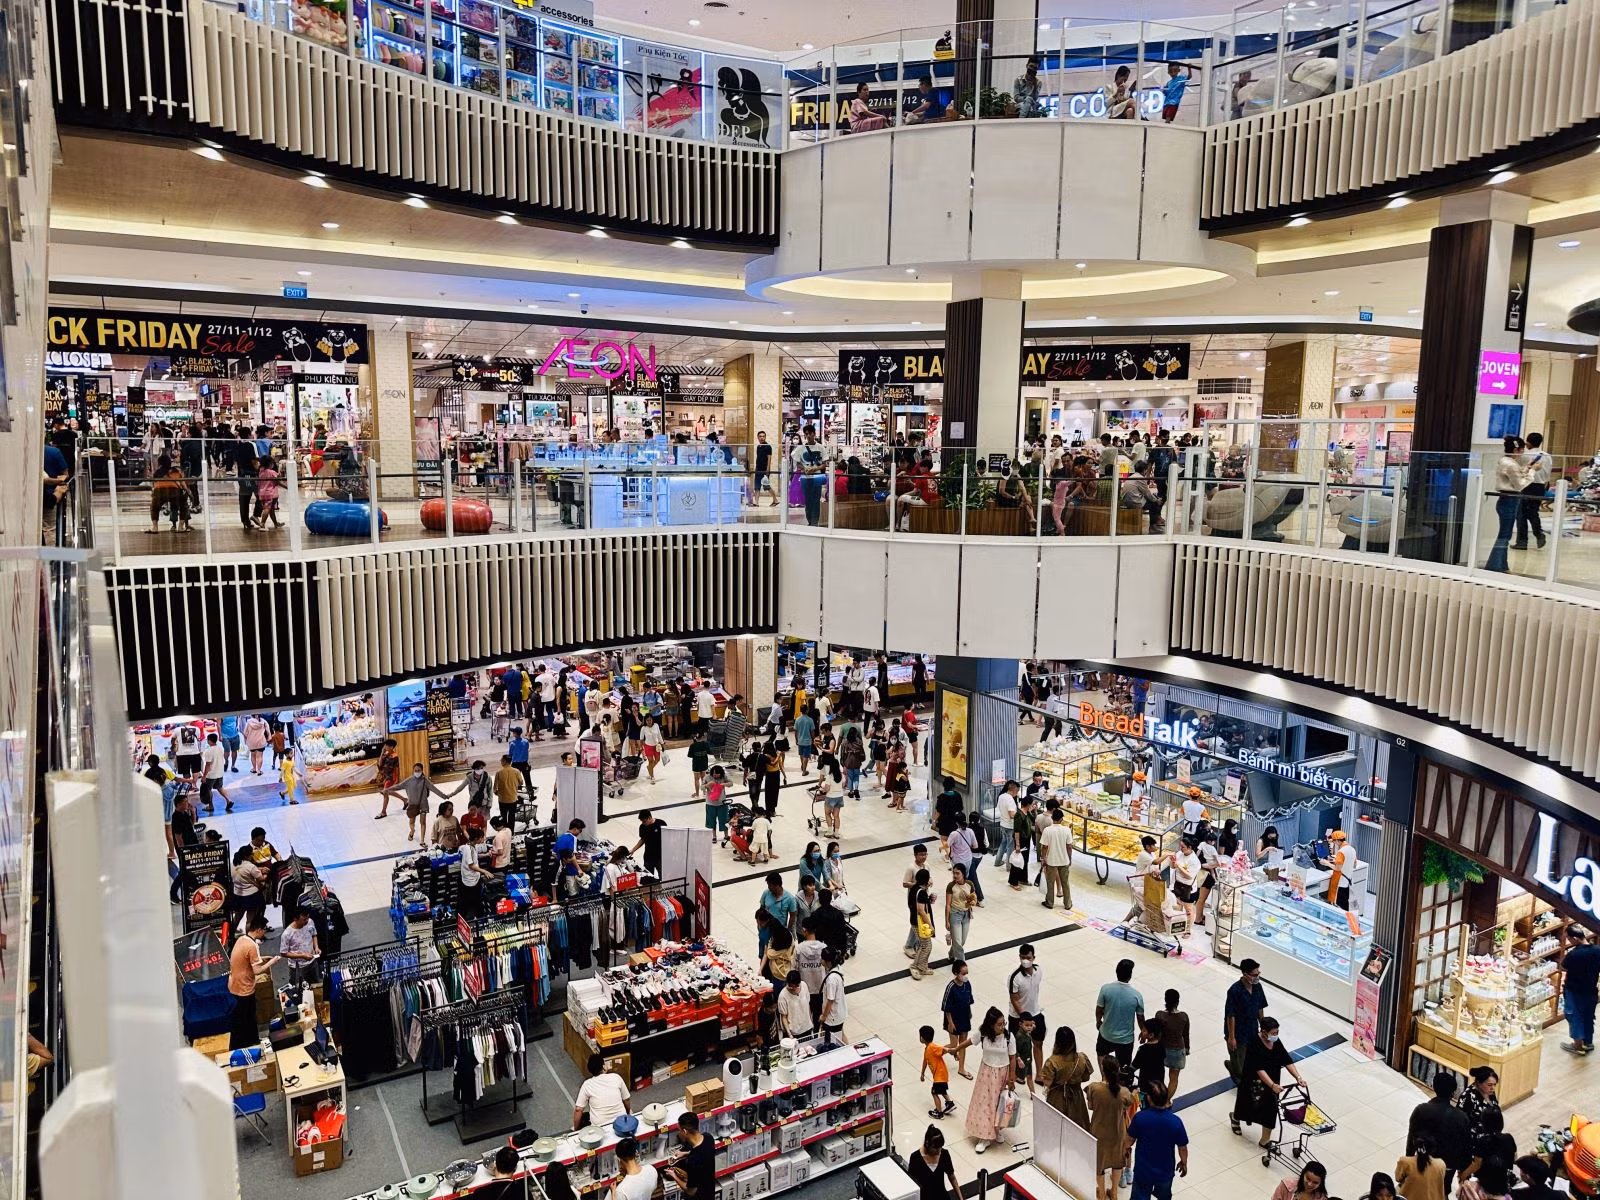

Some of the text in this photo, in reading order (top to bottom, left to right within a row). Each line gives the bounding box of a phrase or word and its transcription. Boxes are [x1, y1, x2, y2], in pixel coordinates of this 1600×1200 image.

[541, 5, 594, 27] accessories
[791, 96, 917, 125] FRIDA 27/11-/12
[286, 289, 300, 297] EXIT
[48, 316, 273, 349] CK FRIDAY 27/11-1/12
[200, 333, 256, 355] Sale
[188, 358, 213, 366] BLACK
[1054, 352, 1106, 361] 27/11-1/12
[188, 365, 215, 374] FRIDAY
[904, 354, 944, 378] BLA
[1047, 358, 1093, 378] Sale
[1482, 361, 1520, 376] JOVEN
[499, 369, 514, 382] 50
[426, 697, 450, 708] BLACK
[1079, 701, 1200, 750] BreadTalk
[1396, 737, 1406, 747] G2
[1238, 748, 1357, 796] Bánh mì biết nói
[184, 852, 203, 861] BLACK
[203, 849, 223, 858] FRIDAY
